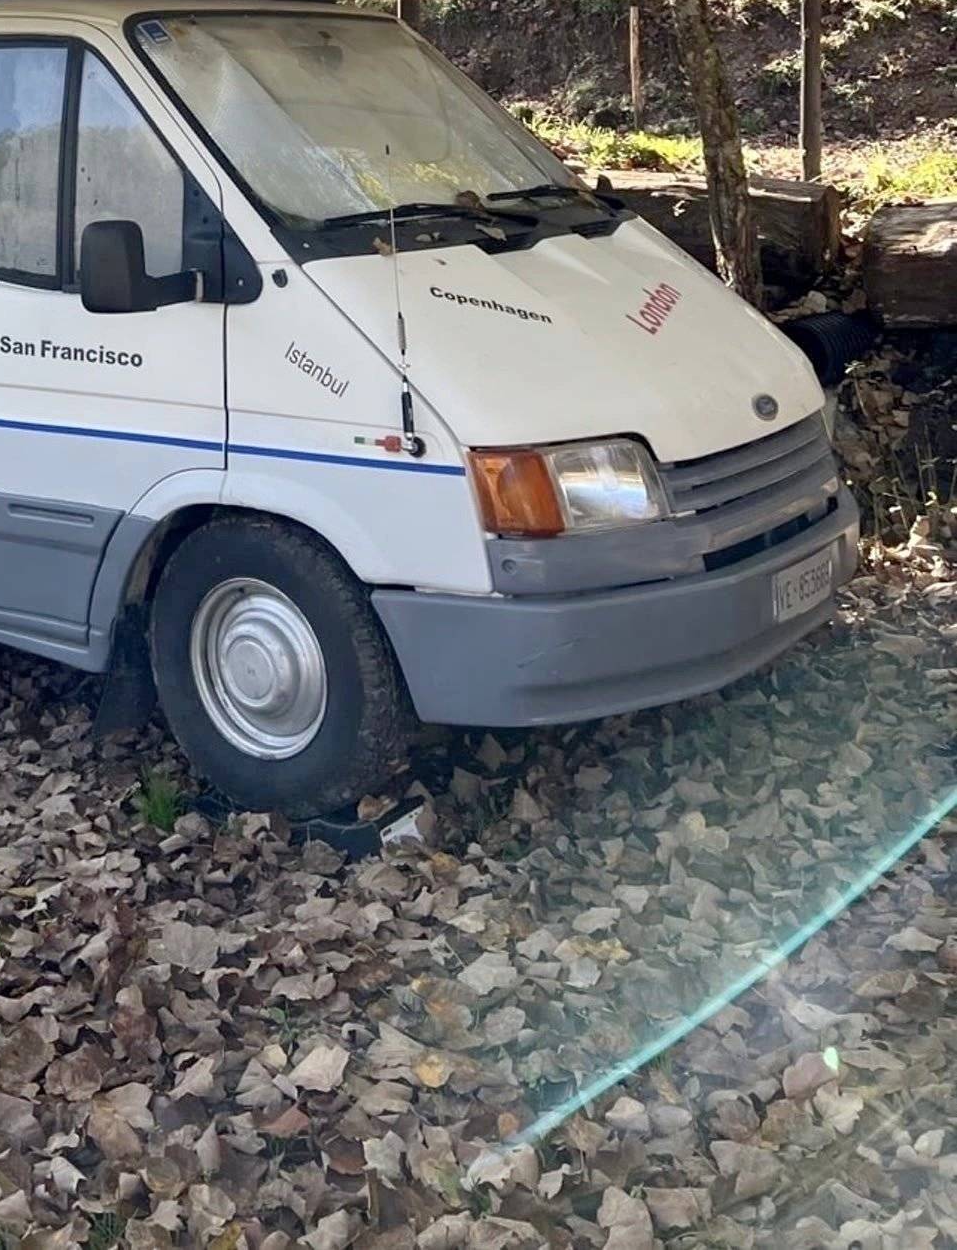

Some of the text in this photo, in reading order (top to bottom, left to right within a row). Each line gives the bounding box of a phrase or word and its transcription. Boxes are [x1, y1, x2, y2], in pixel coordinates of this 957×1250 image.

[429, 286, 552, 324] Copenhagen
[625, 282, 683, 335] London
[0, 336, 143, 367] San Francisco
[284, 341, 350, 398] Istanbul
